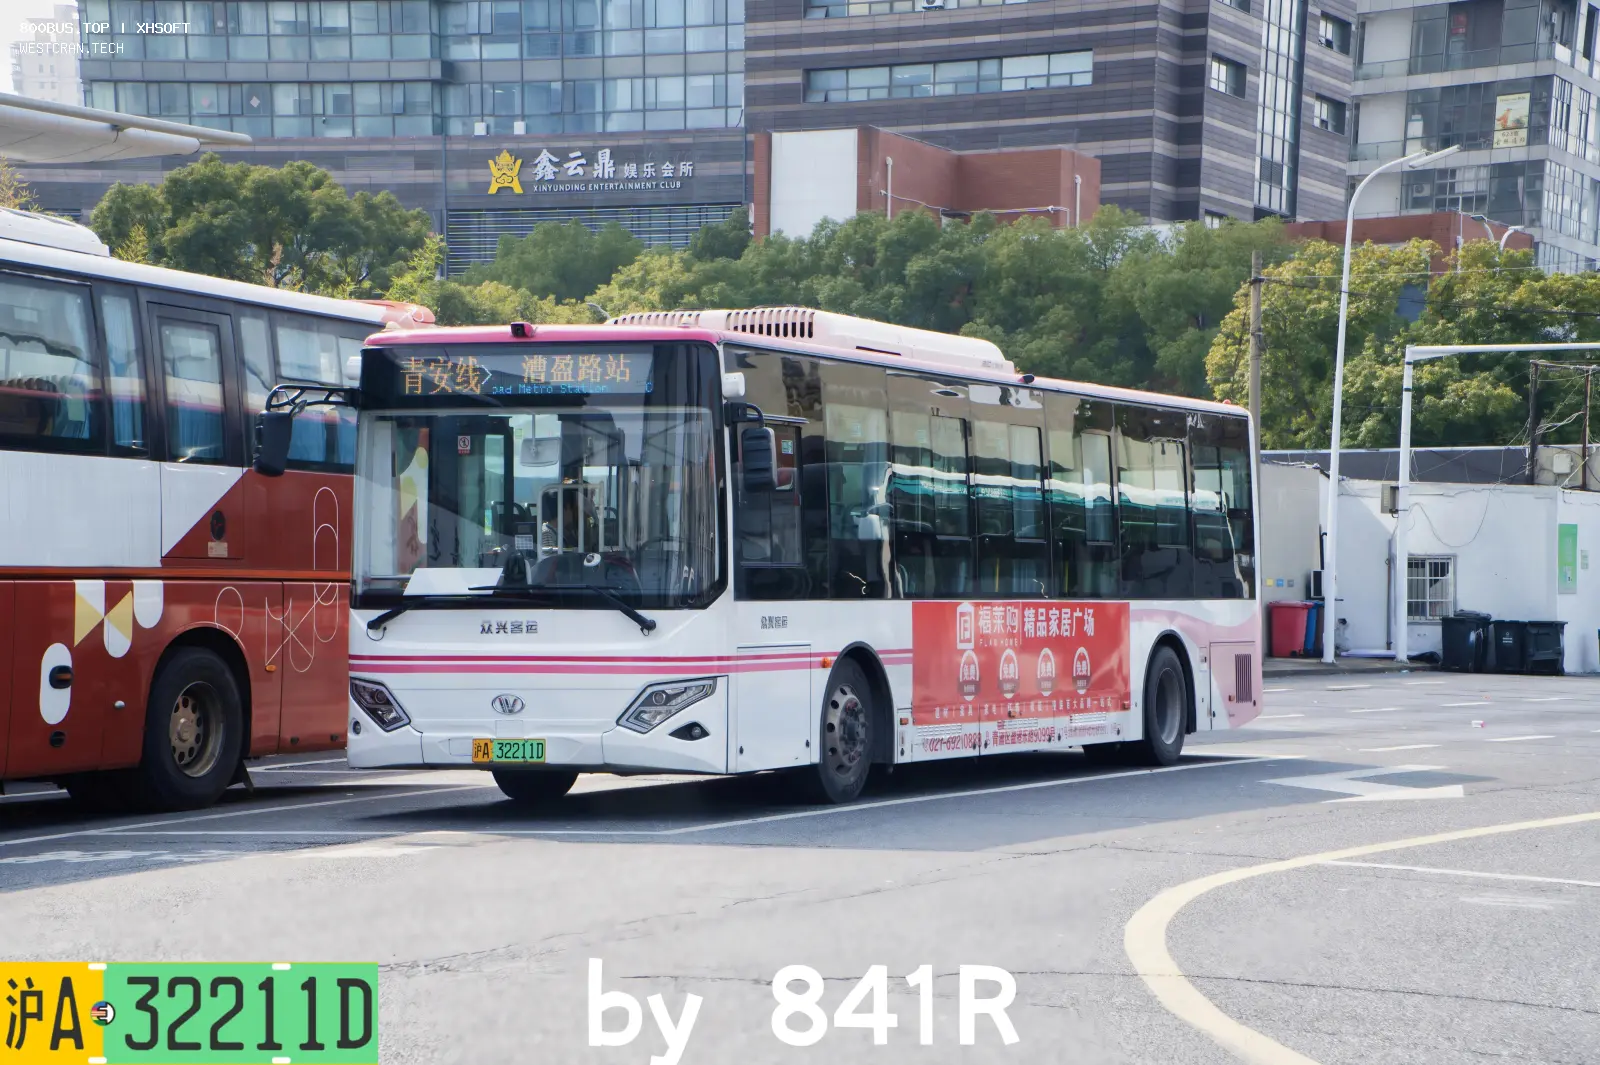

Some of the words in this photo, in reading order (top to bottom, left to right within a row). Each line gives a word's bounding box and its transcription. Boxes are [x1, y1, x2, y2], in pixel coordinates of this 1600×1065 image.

[532, 148, 616, 181] 鑫云鼎
[624, 161, 694, 179] 娱乐会所
[533, 182, 586, 193] XINYUNDING
[588, 181, 657, 191] ENTERTAINMENT
[660, 181, 681, 190] CLUB
[400, 356, 482, 395] 青安线
[523, 353, 632, 384] 漕盈路站
[519, 384, 553, 394] Metro
[560, 383, 609, 394] Station
[480, 620, 538, 634] 众兴客运
[978, 605, 1019, 634] 福莱购
[1023, 607, 1095, 638] 精品家居广场
[496, 742, 544, 759] 32211D
